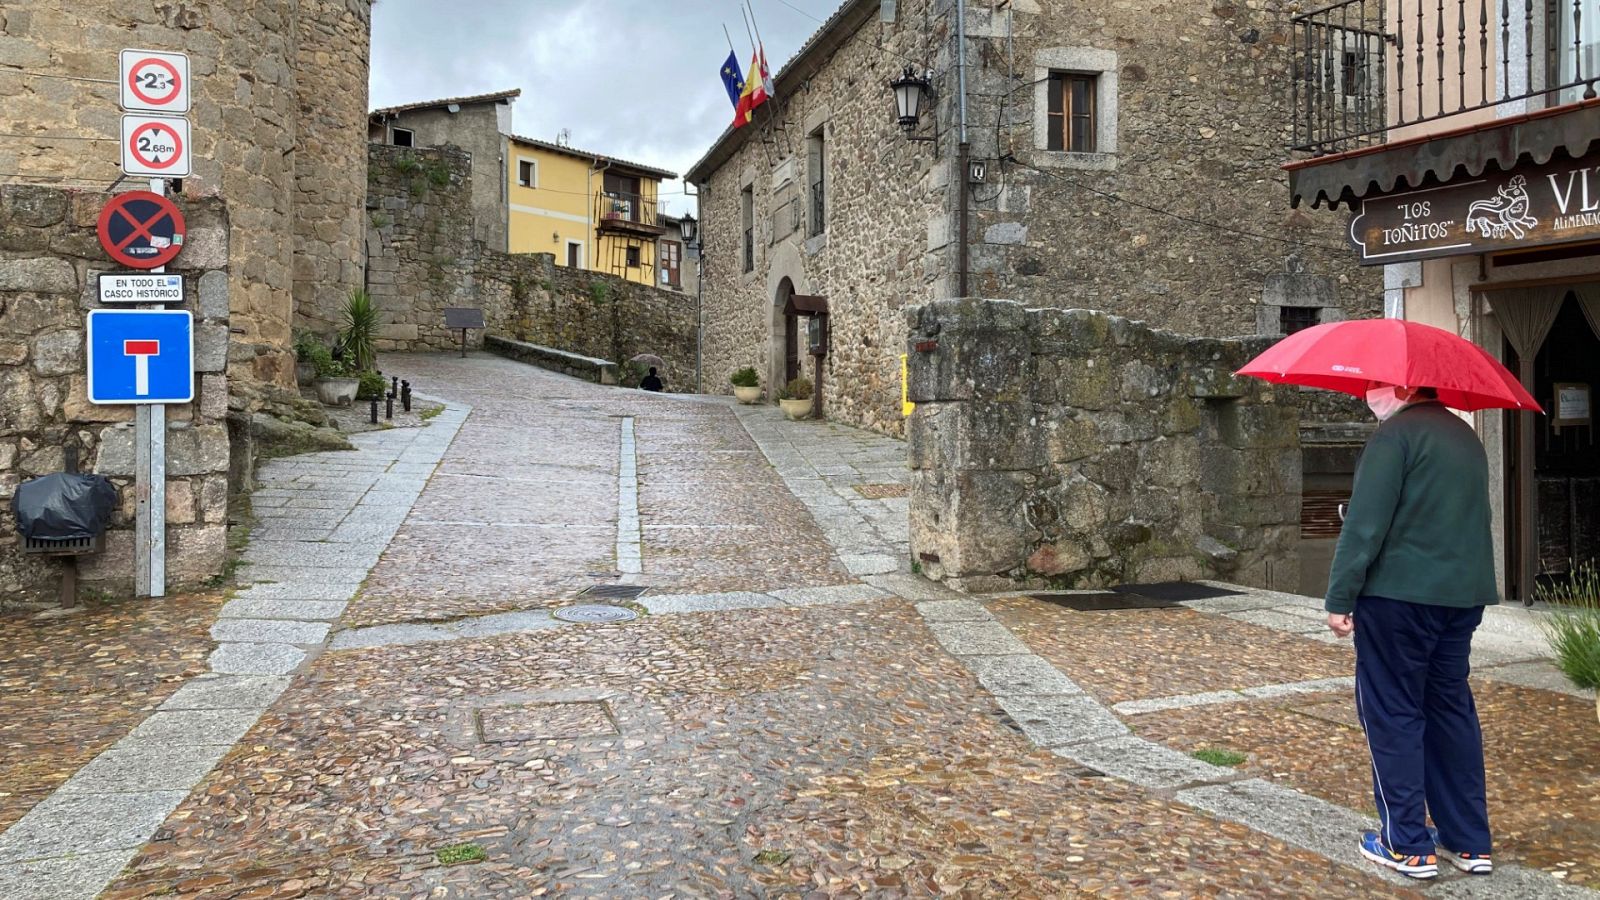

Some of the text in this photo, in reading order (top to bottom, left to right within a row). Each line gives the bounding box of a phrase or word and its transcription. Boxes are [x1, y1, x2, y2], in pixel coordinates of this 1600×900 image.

[1546, 166, 1600, 214] VL
[116, 279, 127, 288] EN
[131, 279, 154, 288] TODO
[157, 279, 166, 288] EL
[104, 290, 133, 298] CASCO
